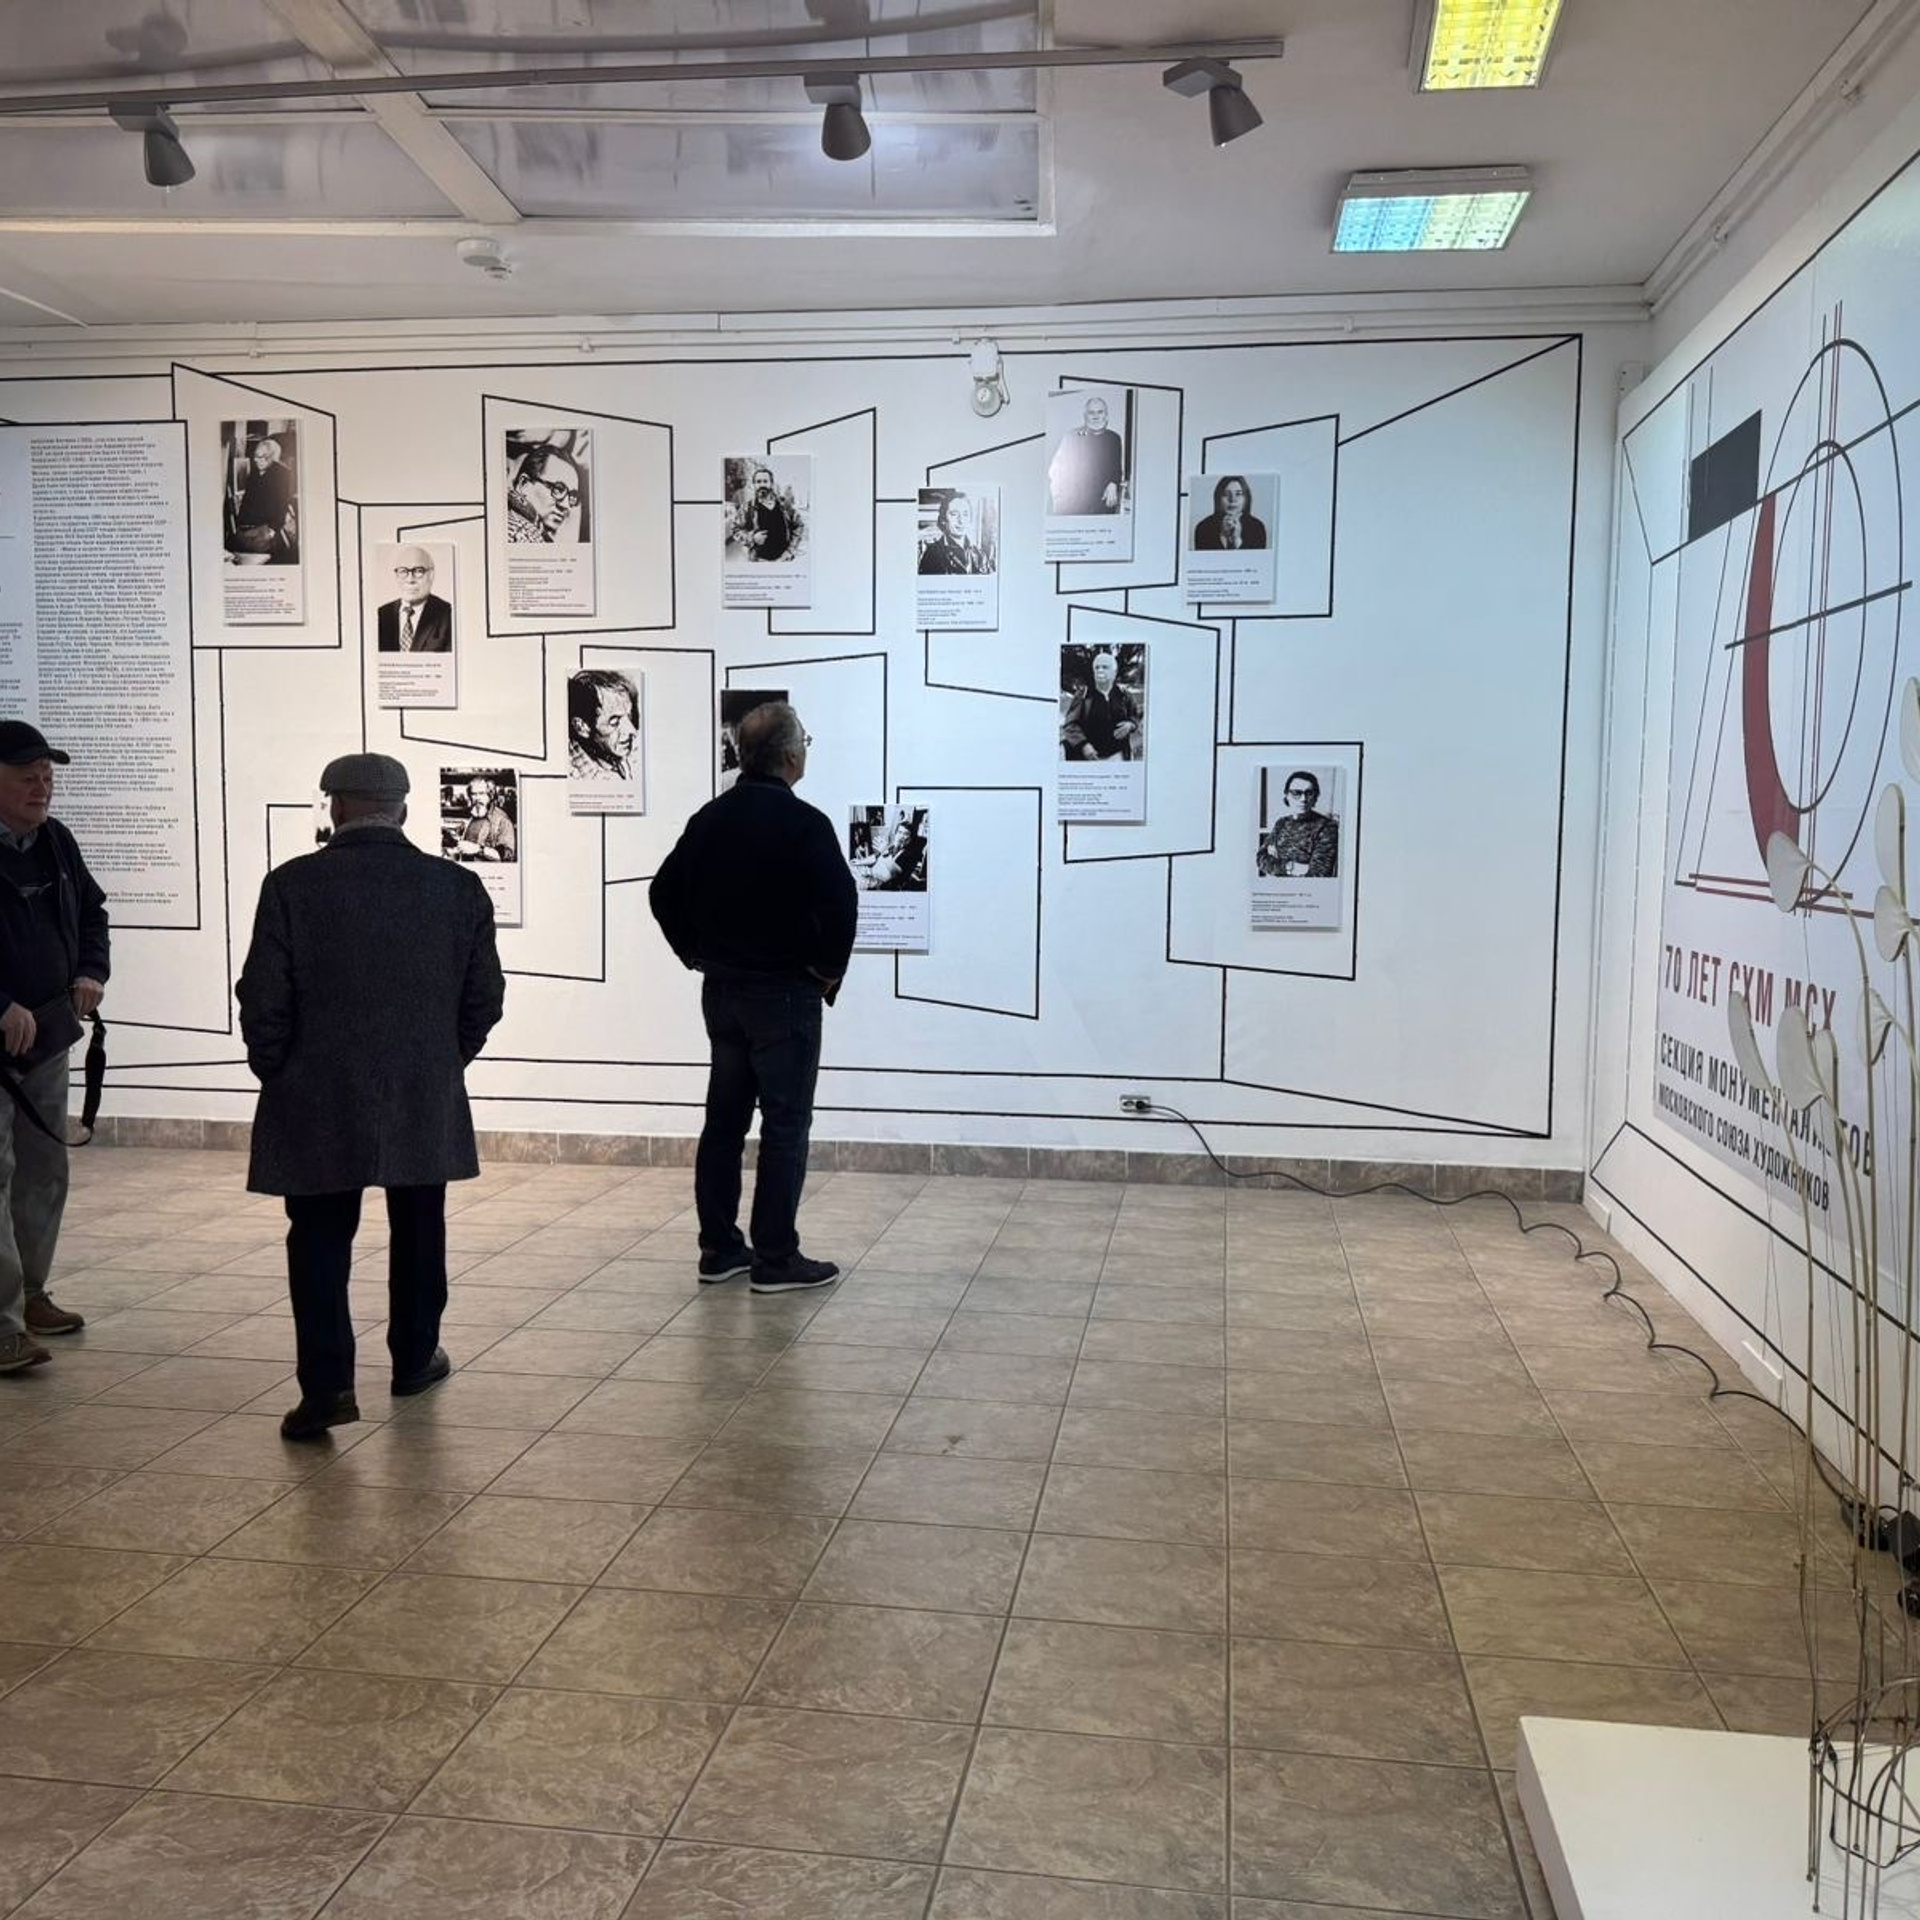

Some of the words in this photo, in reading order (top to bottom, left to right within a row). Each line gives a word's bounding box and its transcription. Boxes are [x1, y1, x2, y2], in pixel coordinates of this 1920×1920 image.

[1665, 944, 1682, 993] 70
[1686, 950, 1722, 1007] ЛЕТ
[1728, 961, 1774, 1027] СХМ
[1784, 977, 1836, 1042] МСХ
[1659, 1082, 1713, 1137] МОСКОВСКОГО
[1716, 1117, 1750, 1161] СОЮЗА
[1660, 1032, 1703, 1086] СЕКЦИЯ
[1708, 1056, 1873, 1177] МОНУМЕНАЛОВ
